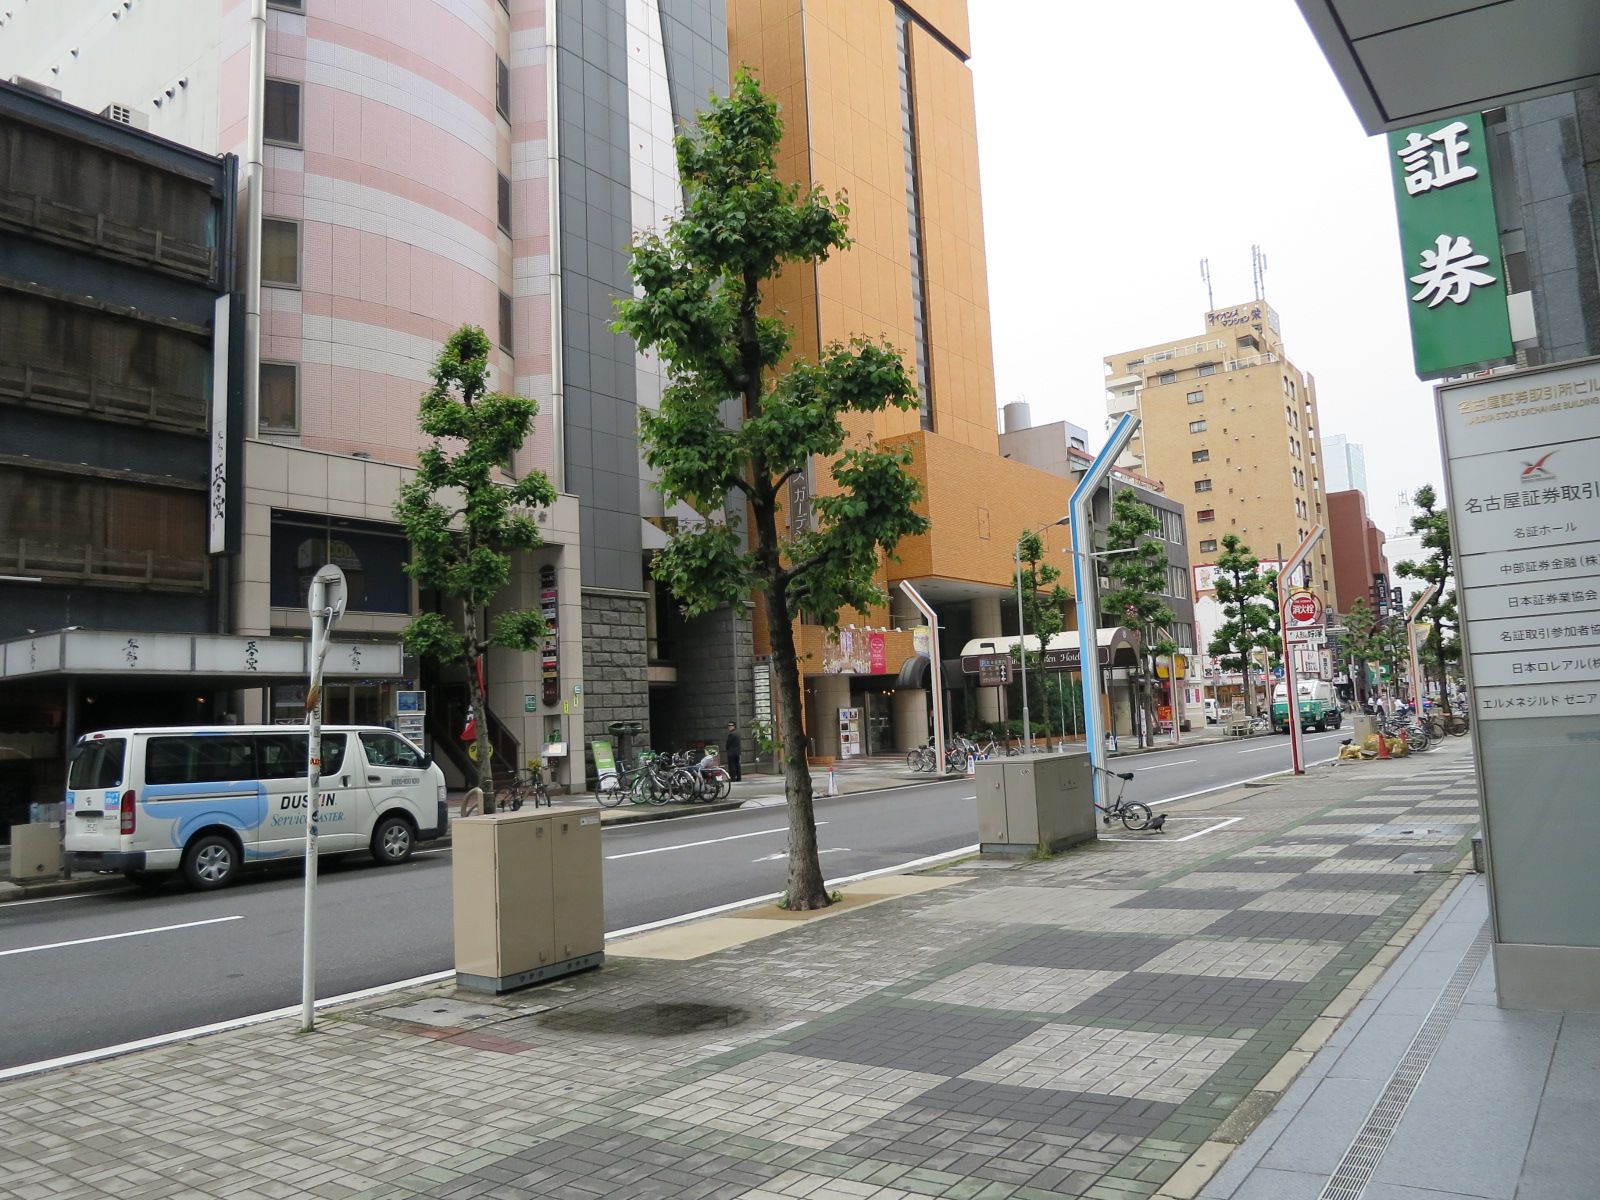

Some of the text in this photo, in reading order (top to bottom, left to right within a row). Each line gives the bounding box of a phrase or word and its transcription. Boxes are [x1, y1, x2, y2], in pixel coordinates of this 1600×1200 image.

[1397, 121, 1497, 308] 証券
[1495, 409, 1519, 421] STOCK
[1519, 401, 1561, 417] EXCHANGE
[1563, 395, 1600, 410] BUILDING
[1465, 481, 1600, 514] 名古屋証券取引
[1513, 522, 1577, 539] 名証ホール
[1508, 590, 1598, 608] 日本証券業協会
[1292, 603, 1315, 615] 消火栓
[1483, 693, 1598, 709] エルメネジルド ゼニア
[280, 792, 337, 810] DUSIN
